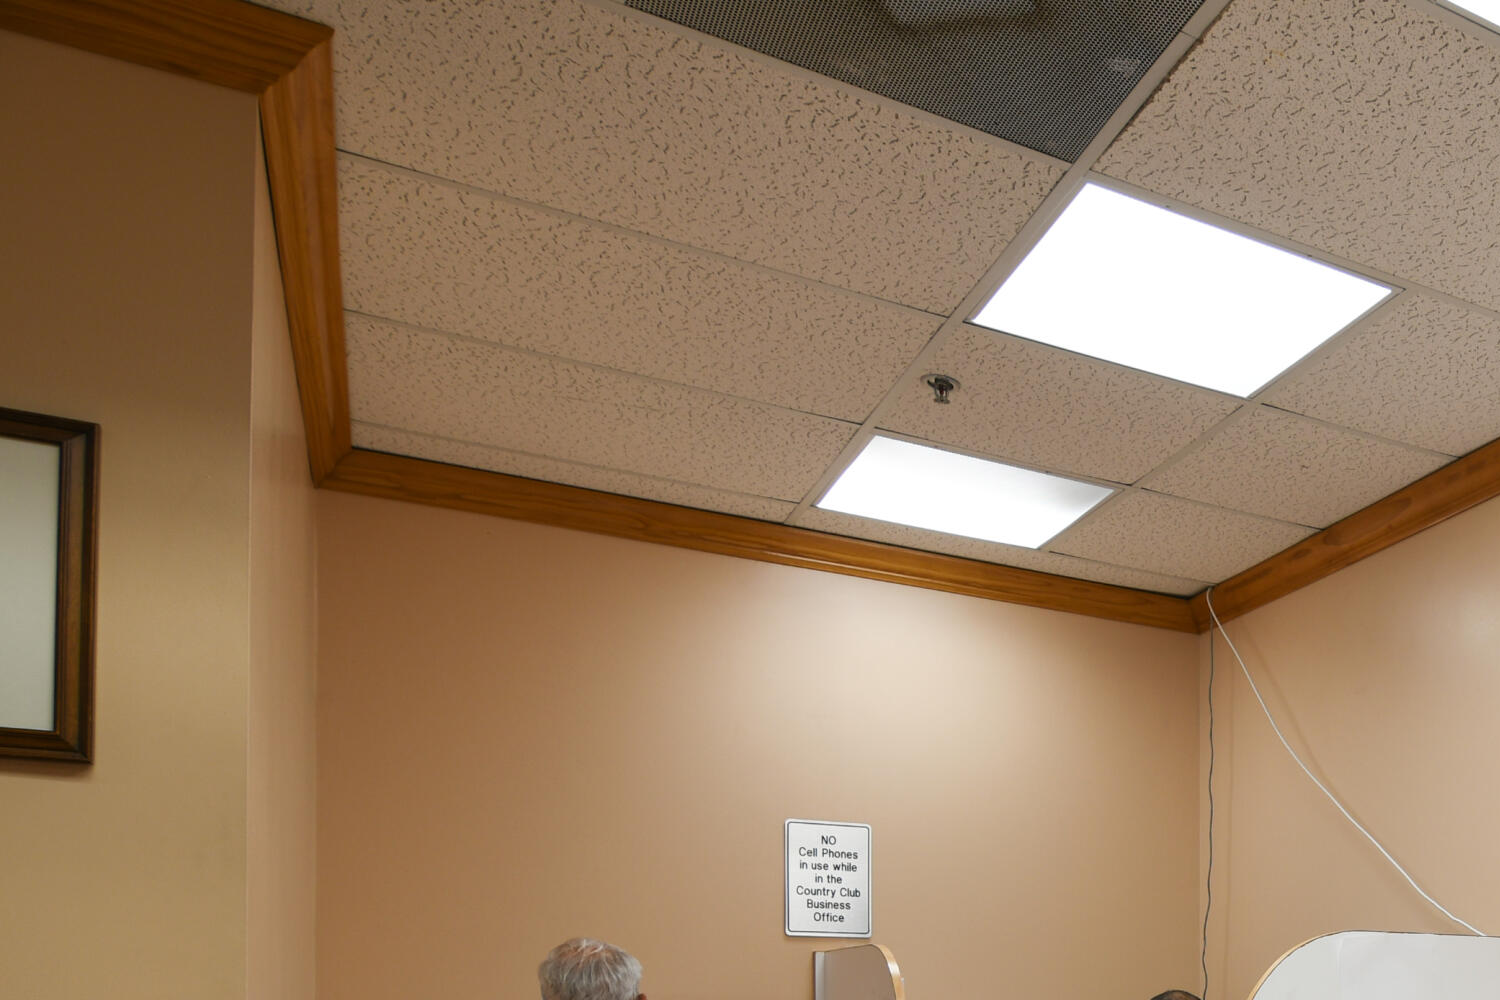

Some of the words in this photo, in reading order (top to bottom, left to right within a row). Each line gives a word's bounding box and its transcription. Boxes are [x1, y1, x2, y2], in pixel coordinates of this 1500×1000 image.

[821, 835, 837, 845] NO
[799, 847, 818, 857] Cell
[822, 848, 858, 859] Phones
[800, 860, 808, 869] in
[811, 862, 829, 870] use
[833, 862, 857, 872] while
[815, 873, 823, 883] in
[827, 875, 843, 884] the
[796, 885, 836, 898] Country
[840, 887, 861, 898] Club
[807, 899, 851, 910] Business
[814, 912, 845, 922] Office
